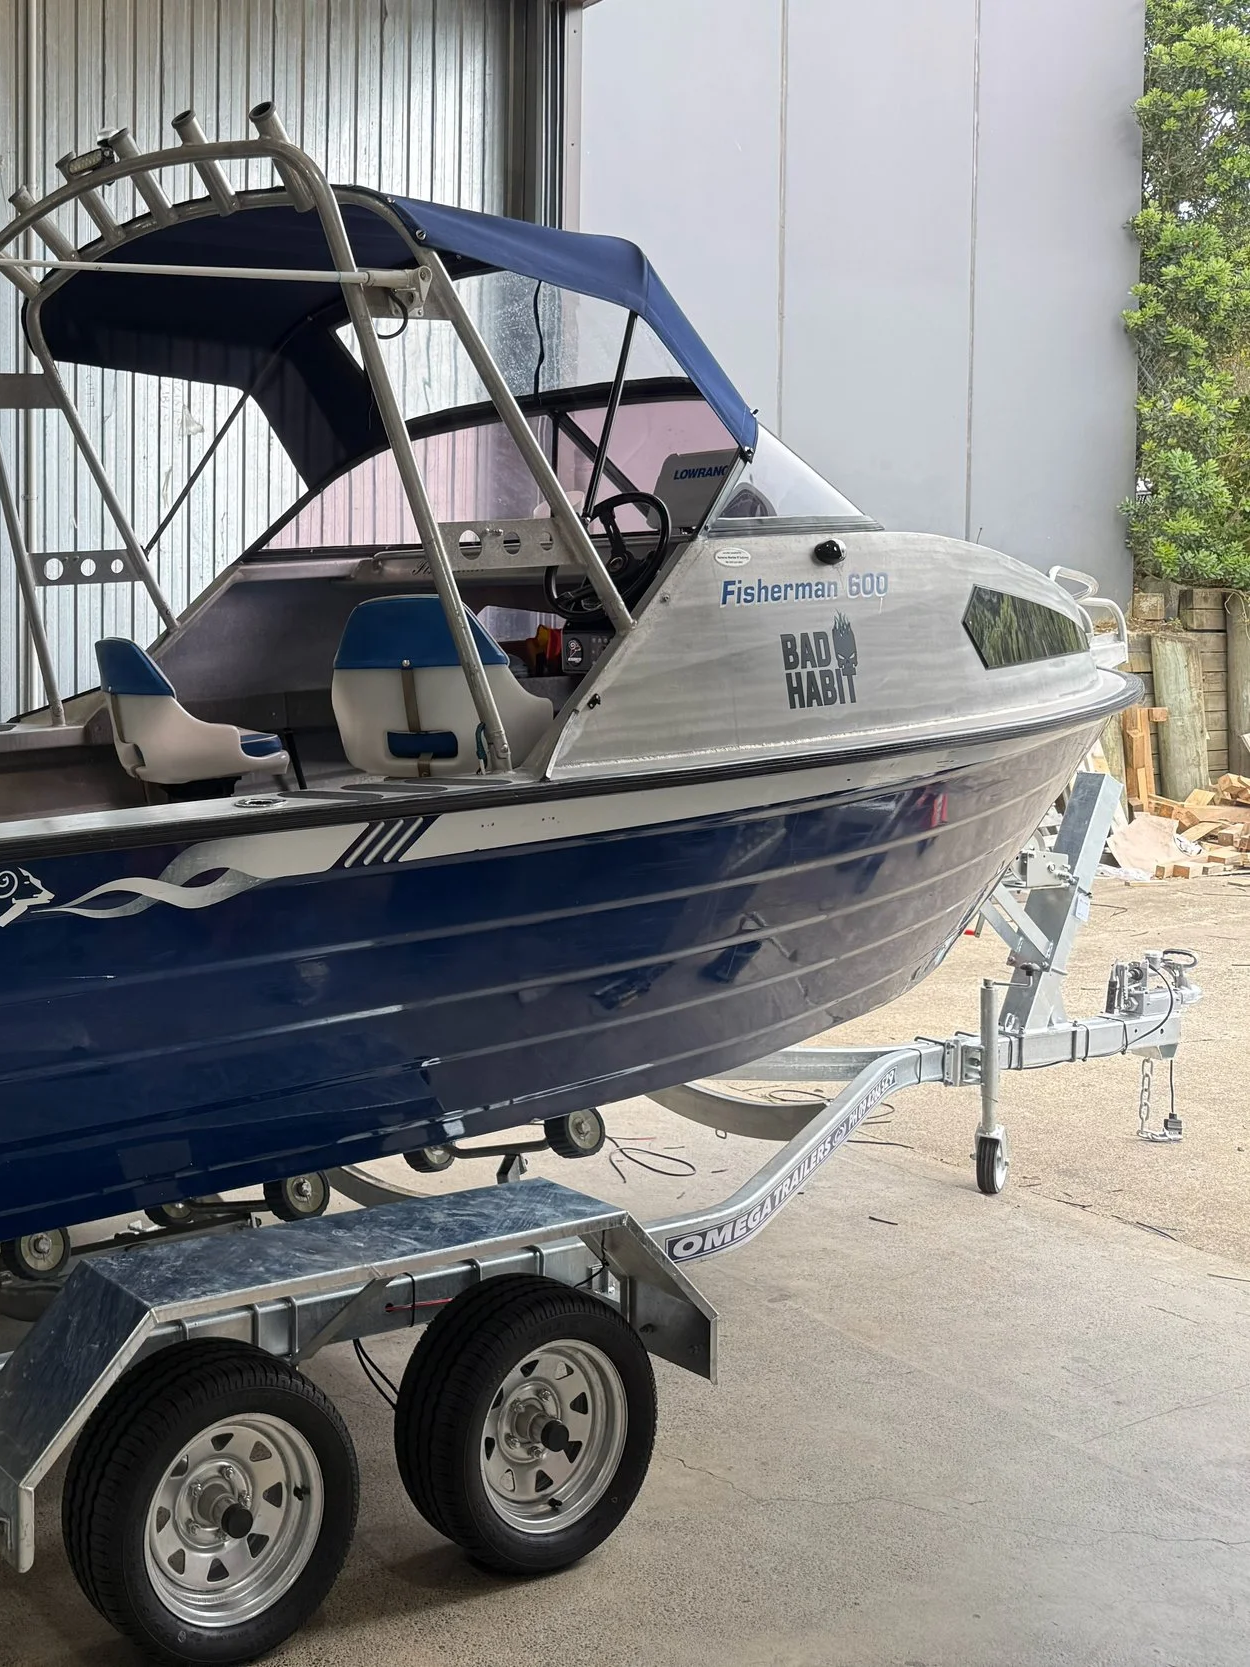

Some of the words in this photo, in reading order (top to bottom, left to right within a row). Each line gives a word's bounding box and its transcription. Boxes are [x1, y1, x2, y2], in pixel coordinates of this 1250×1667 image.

[720, 577, 838, 608] Fisherman
[846, 571, 889, 598] 600
[780, 631, 831, 671] BAD
[785, 667, 857, 710] HABIT
[672, 1201, 773, 1258] OMEGA
[772, 1136, 832, 1205] TRAILERS
